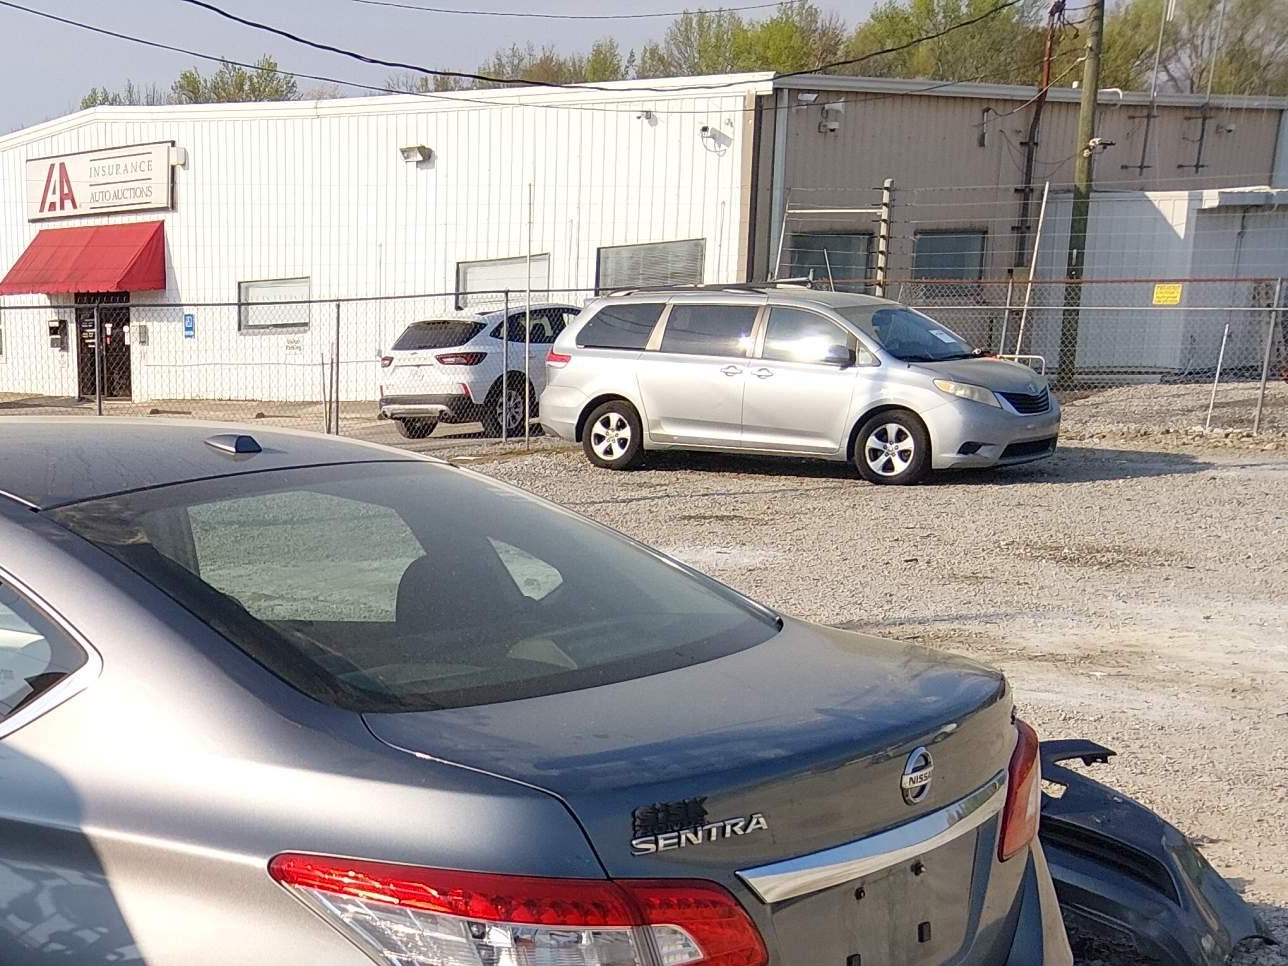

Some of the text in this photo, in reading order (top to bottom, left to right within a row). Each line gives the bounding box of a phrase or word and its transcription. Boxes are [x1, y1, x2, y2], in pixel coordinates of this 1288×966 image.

[89, 160, 152, 178] INSURANCE
[89, 185, 152, 203] AUTO AUCTIONS
[908, 770, 932, 785] NISS
[631, 812, 769, 856] SENTRA
